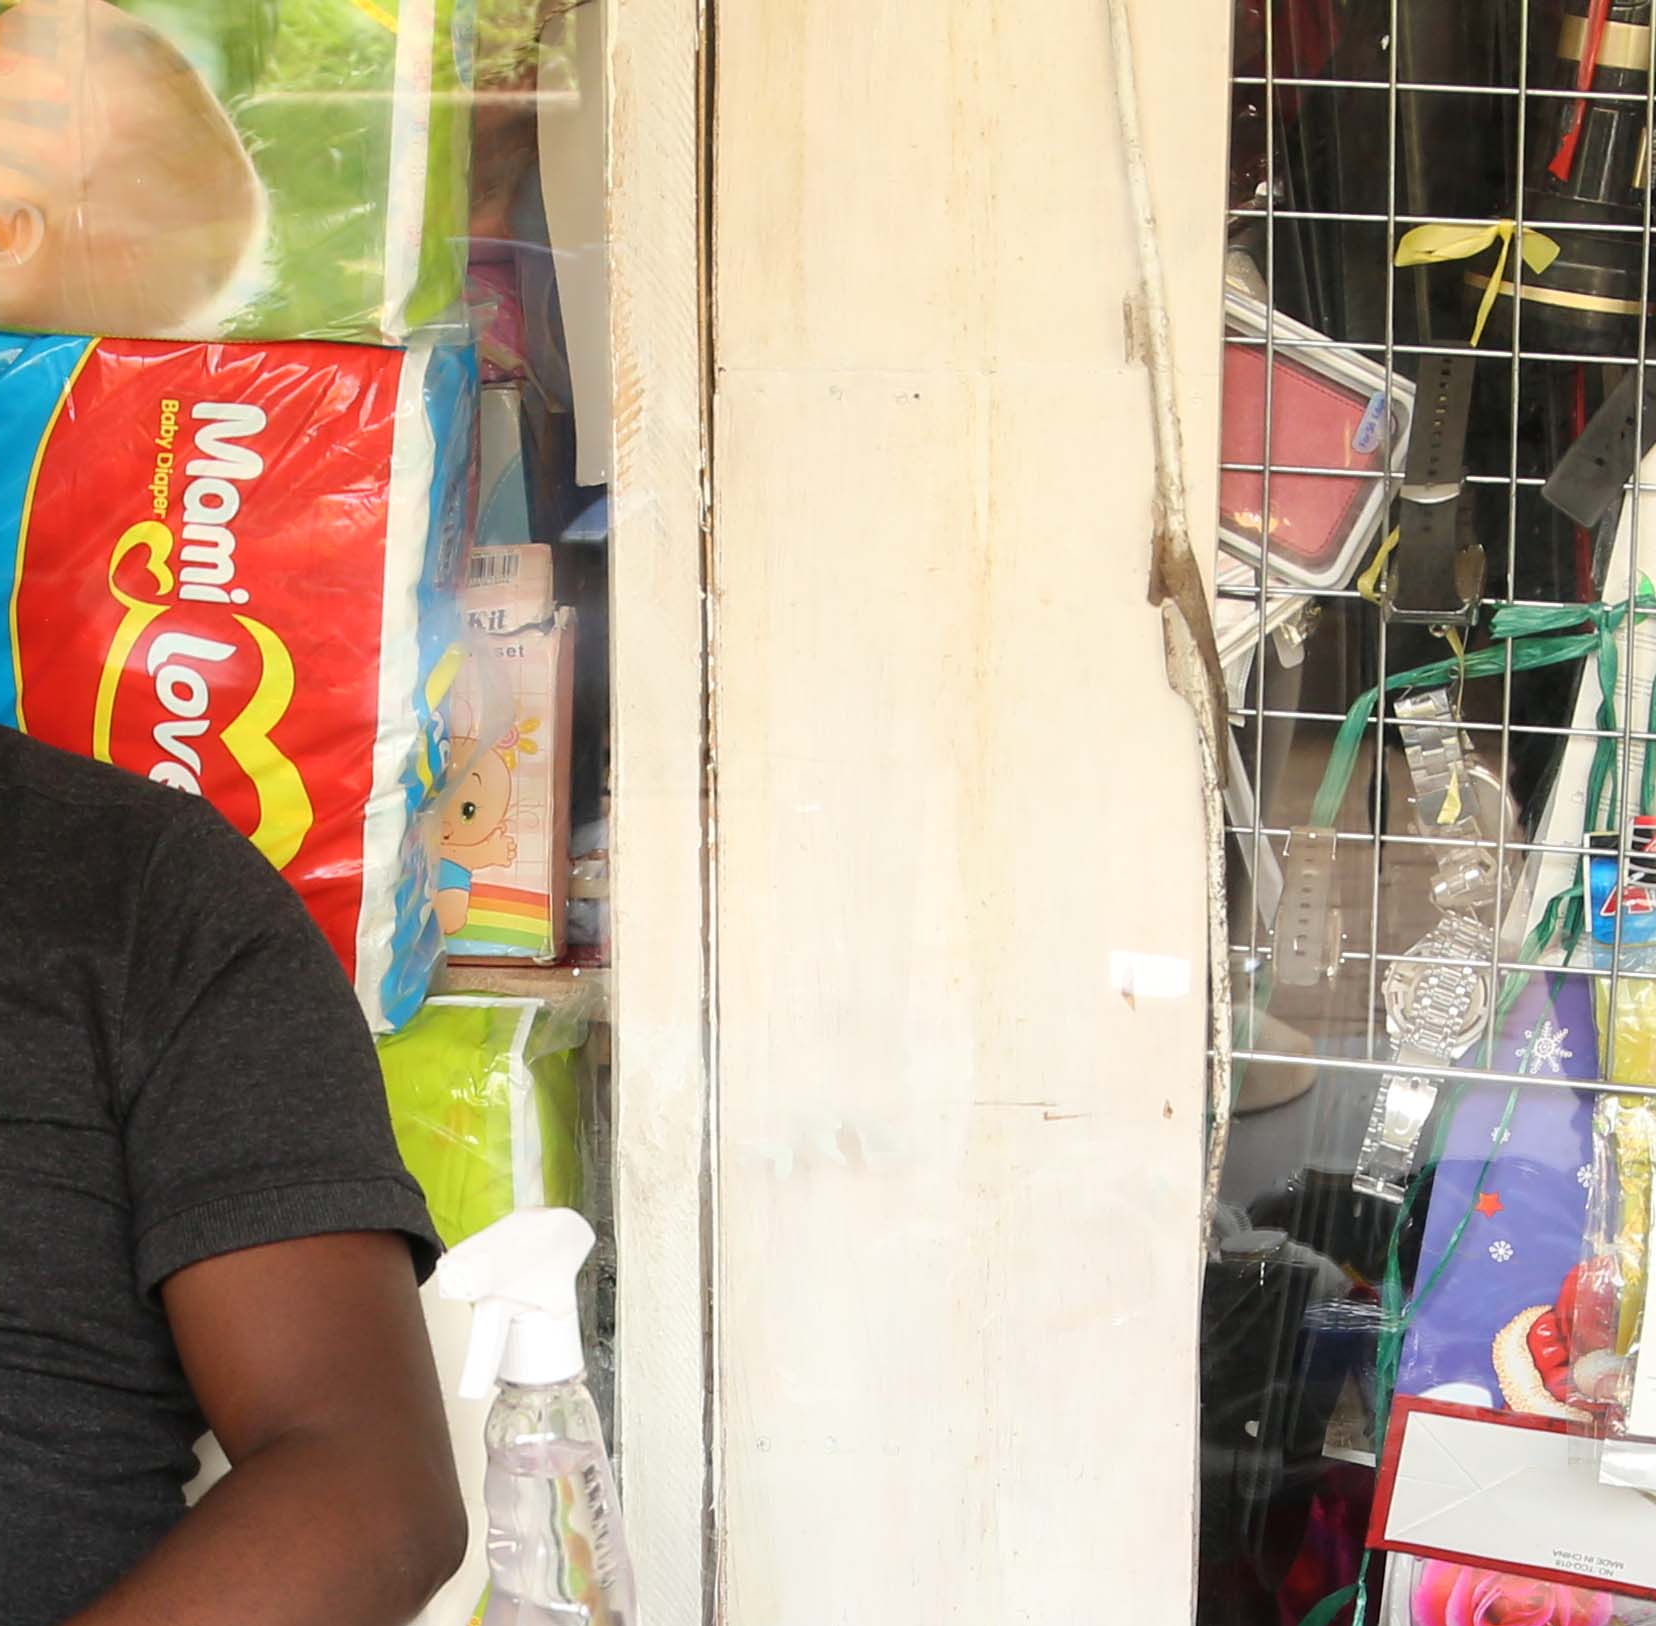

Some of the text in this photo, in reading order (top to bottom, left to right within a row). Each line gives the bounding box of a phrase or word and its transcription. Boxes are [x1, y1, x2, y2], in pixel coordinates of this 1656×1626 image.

[147, 399, 180, 519] Baby Diaper
[146, 402, 267, 796] Mami Love
